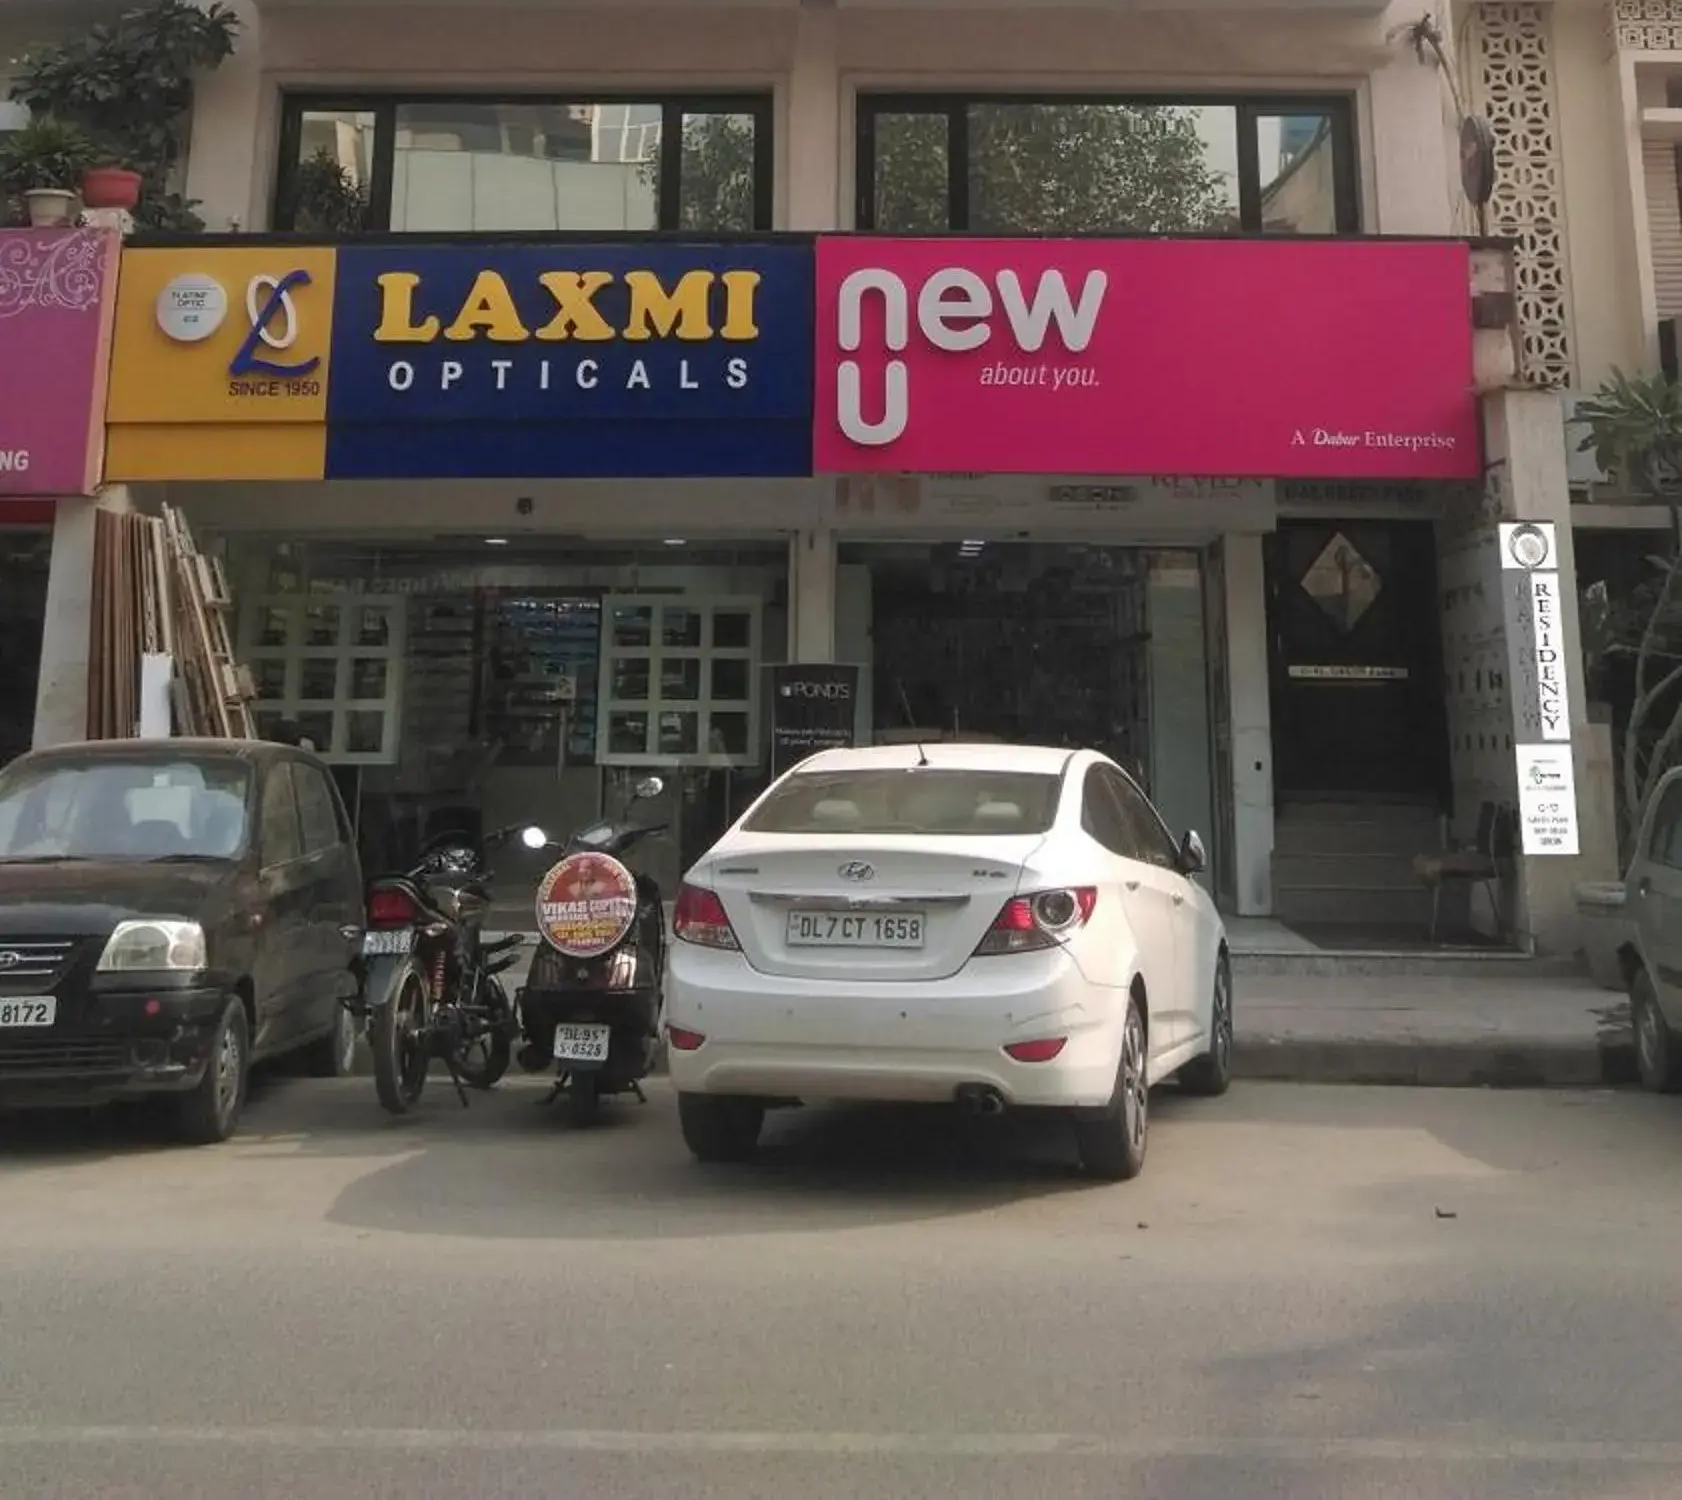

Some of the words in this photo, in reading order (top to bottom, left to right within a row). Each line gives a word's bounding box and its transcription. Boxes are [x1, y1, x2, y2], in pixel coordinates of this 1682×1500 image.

[373, 269, 762, 343] LAXMI
[838, 267, 1108, 352] new
[228, 381, 279, 396] SINCE
[284, 381, 320, 396] 1950
[388, 359, 748, 390] OPTICALS
[980, 362, 1048, 386] about
[1051, 366, 1100, 391] you.
[1290, 429, 1306, 446] A
[1312, 427, 1361, 446] Dabur
[1364, 430, 1456, 451] Enterprise
[1534, 582, 1561, 731] RESIDENCY
[873, 918, 920, 940] 1658
[1, 1003, 47, 1023] 8172
